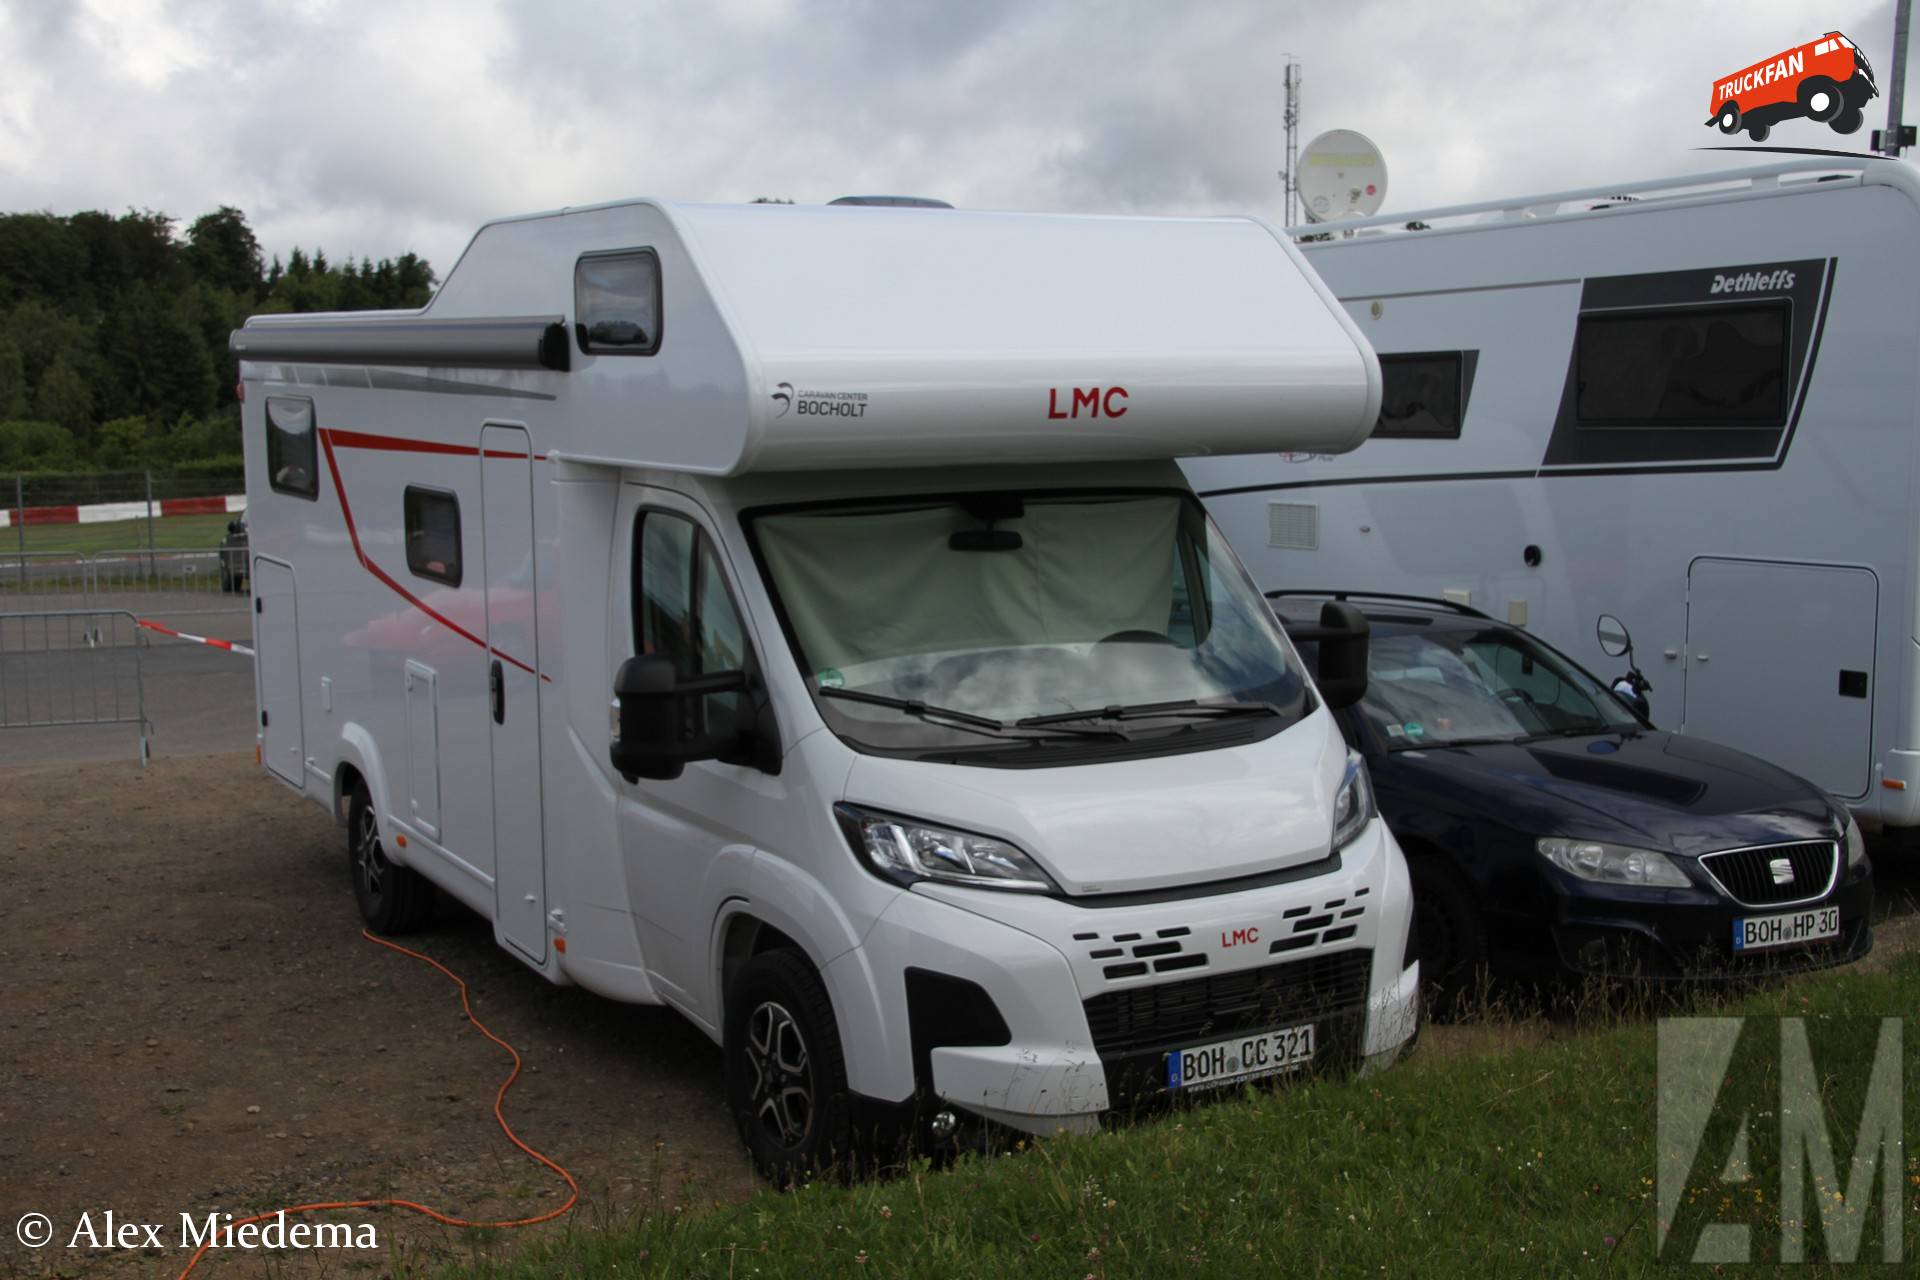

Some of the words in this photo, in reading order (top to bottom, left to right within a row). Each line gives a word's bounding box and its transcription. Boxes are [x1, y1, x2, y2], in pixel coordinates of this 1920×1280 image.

[1710, 270, 1796, 294] Dethleffs
[798, 390, 836, 399] CARAVAN
[837, 392, 868, 401] CENTER
[1048, 386, 1129, 419] LMC
[798, 400, 868, 417] BOCHOLT
[1222, 927, 1259, 948] LMC
[1745, 918, 1781, 945] BOH
[1793, 914, 1815, 938] HP
[1819, 909, 1838, 933] 30
[1183, 1046, 1225, 1081] BOH
[1241, 1038, 1268, 1068] CC
[1273, 1029, 1312, 1062] 321
